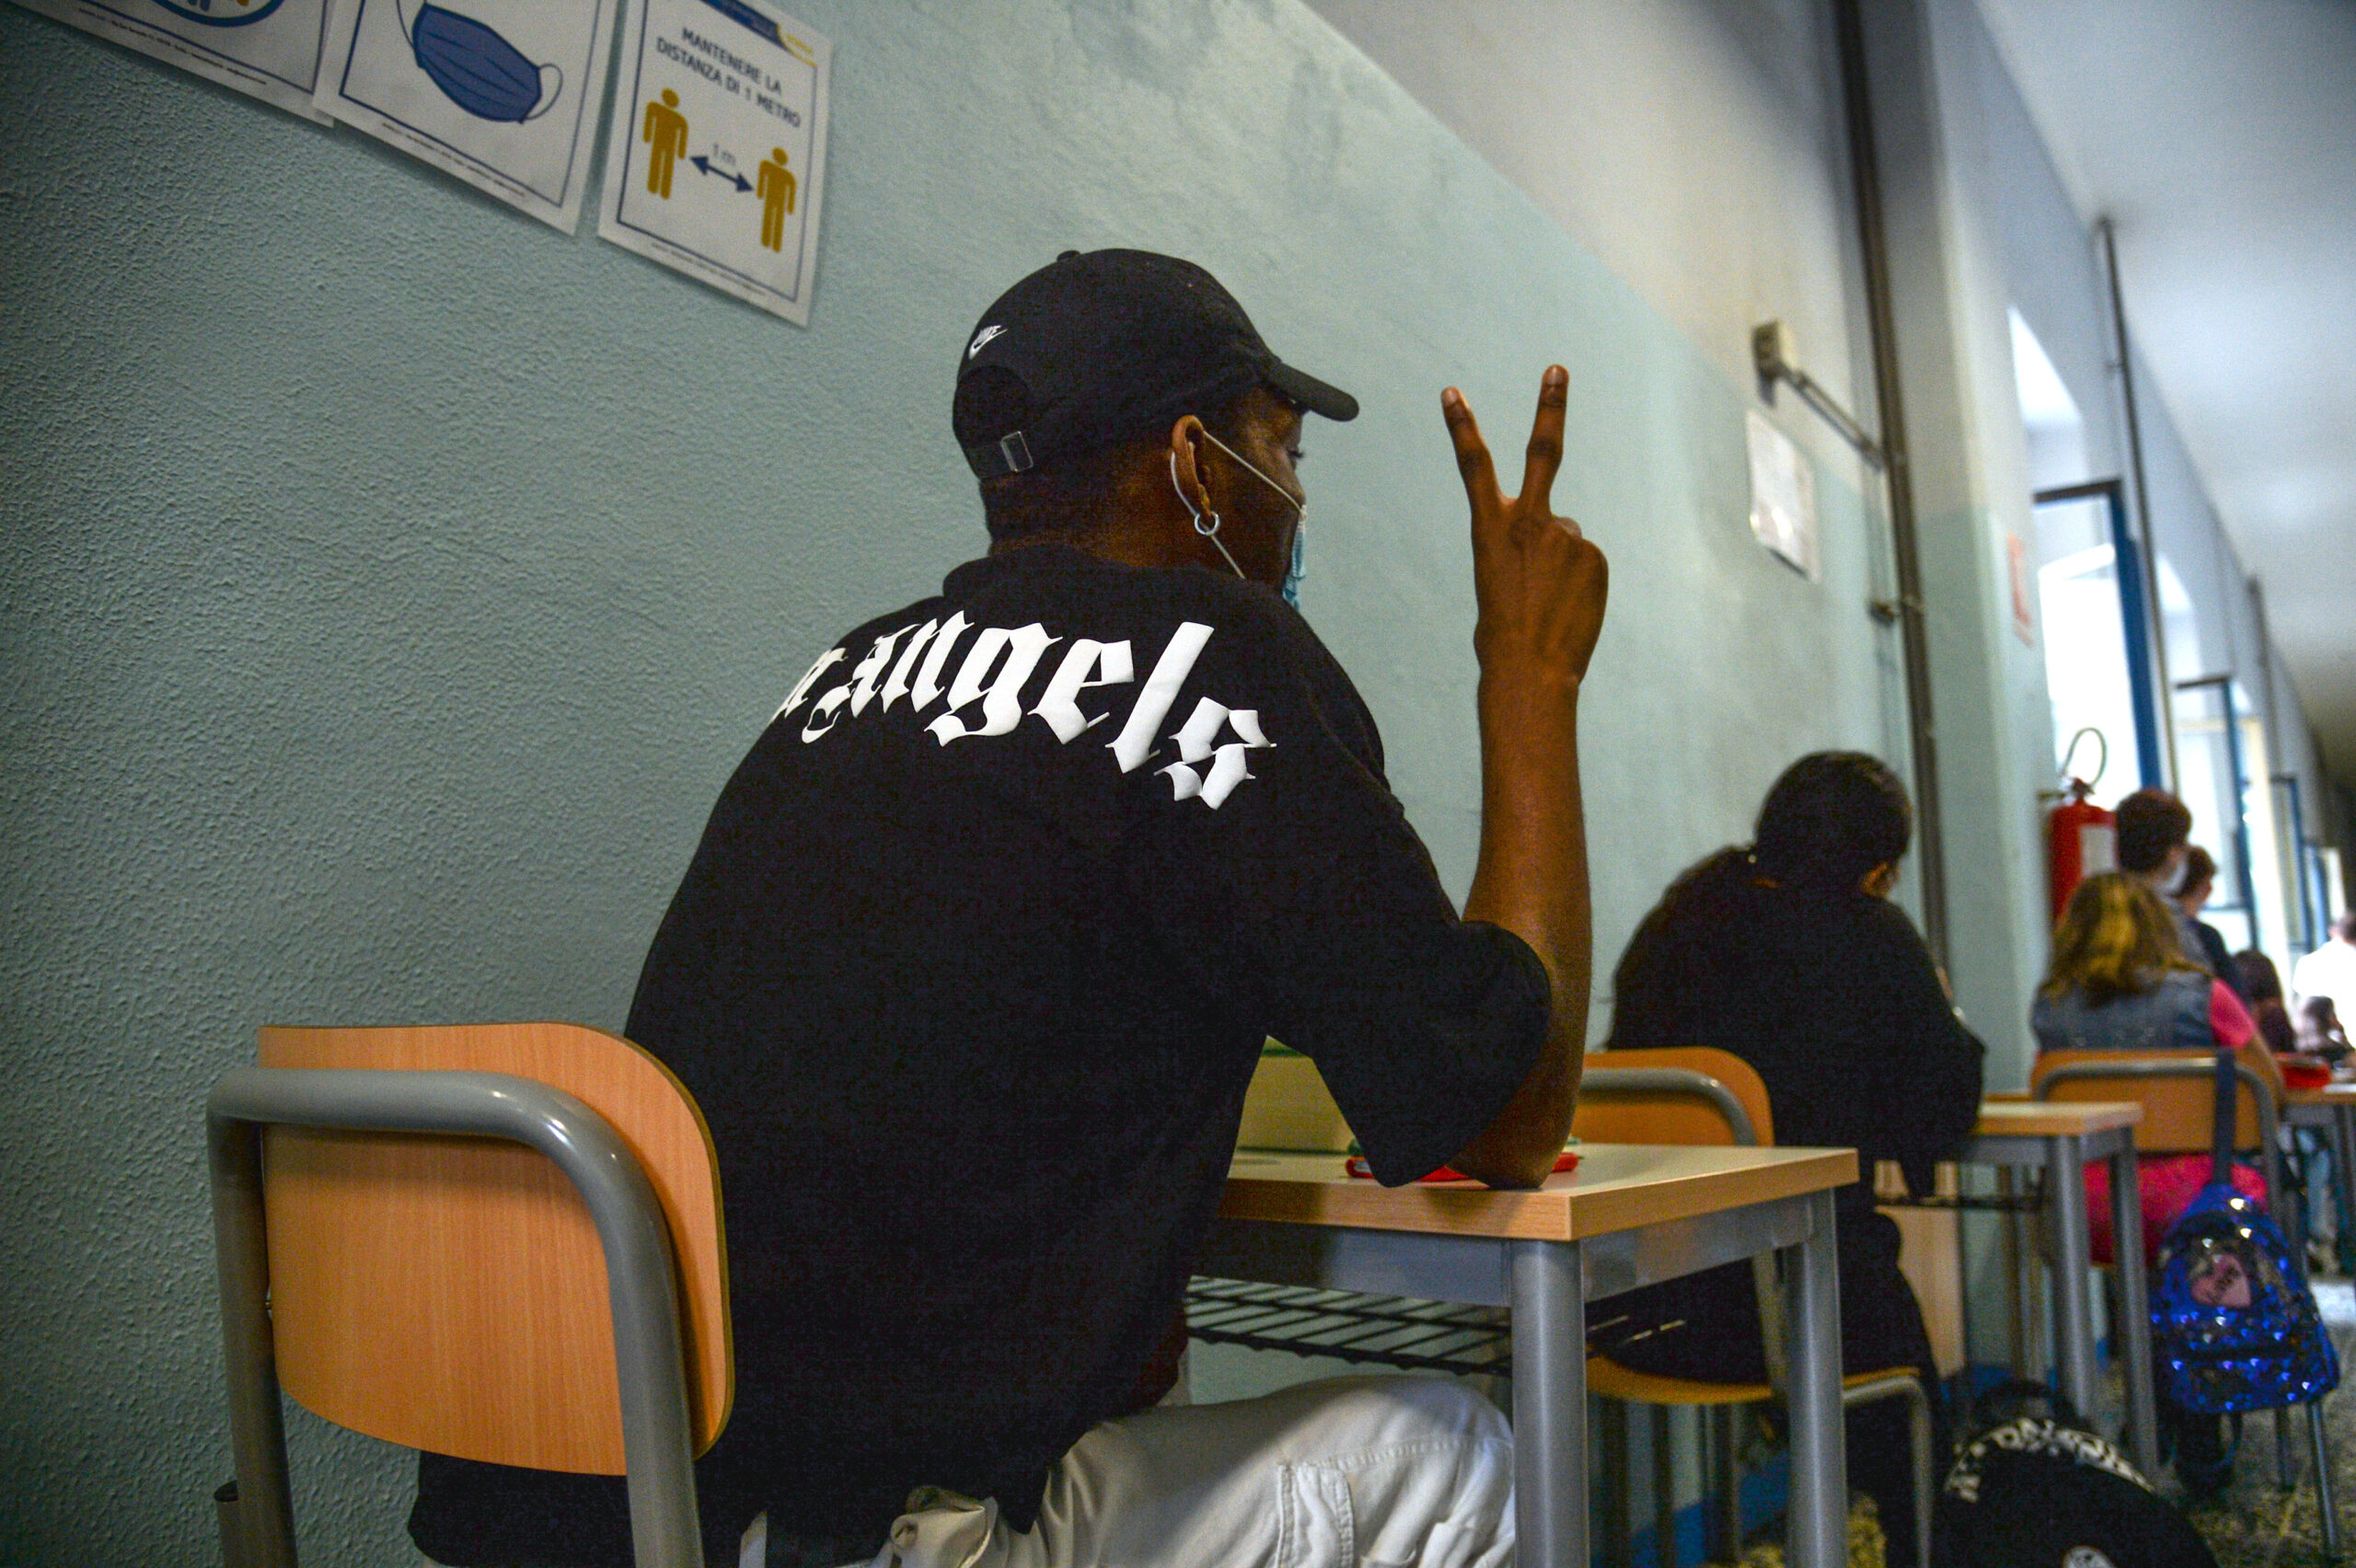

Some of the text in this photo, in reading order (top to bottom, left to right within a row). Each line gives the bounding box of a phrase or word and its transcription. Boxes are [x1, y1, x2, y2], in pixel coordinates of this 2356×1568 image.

[656, 36, 722, 86] DISTANZA
[726, 75, 740, 95] DI
[756, 93, 802, 129] METRO
[682, 28, 762, 85] MANTENERE
[765, 75, 781, 95] LA
